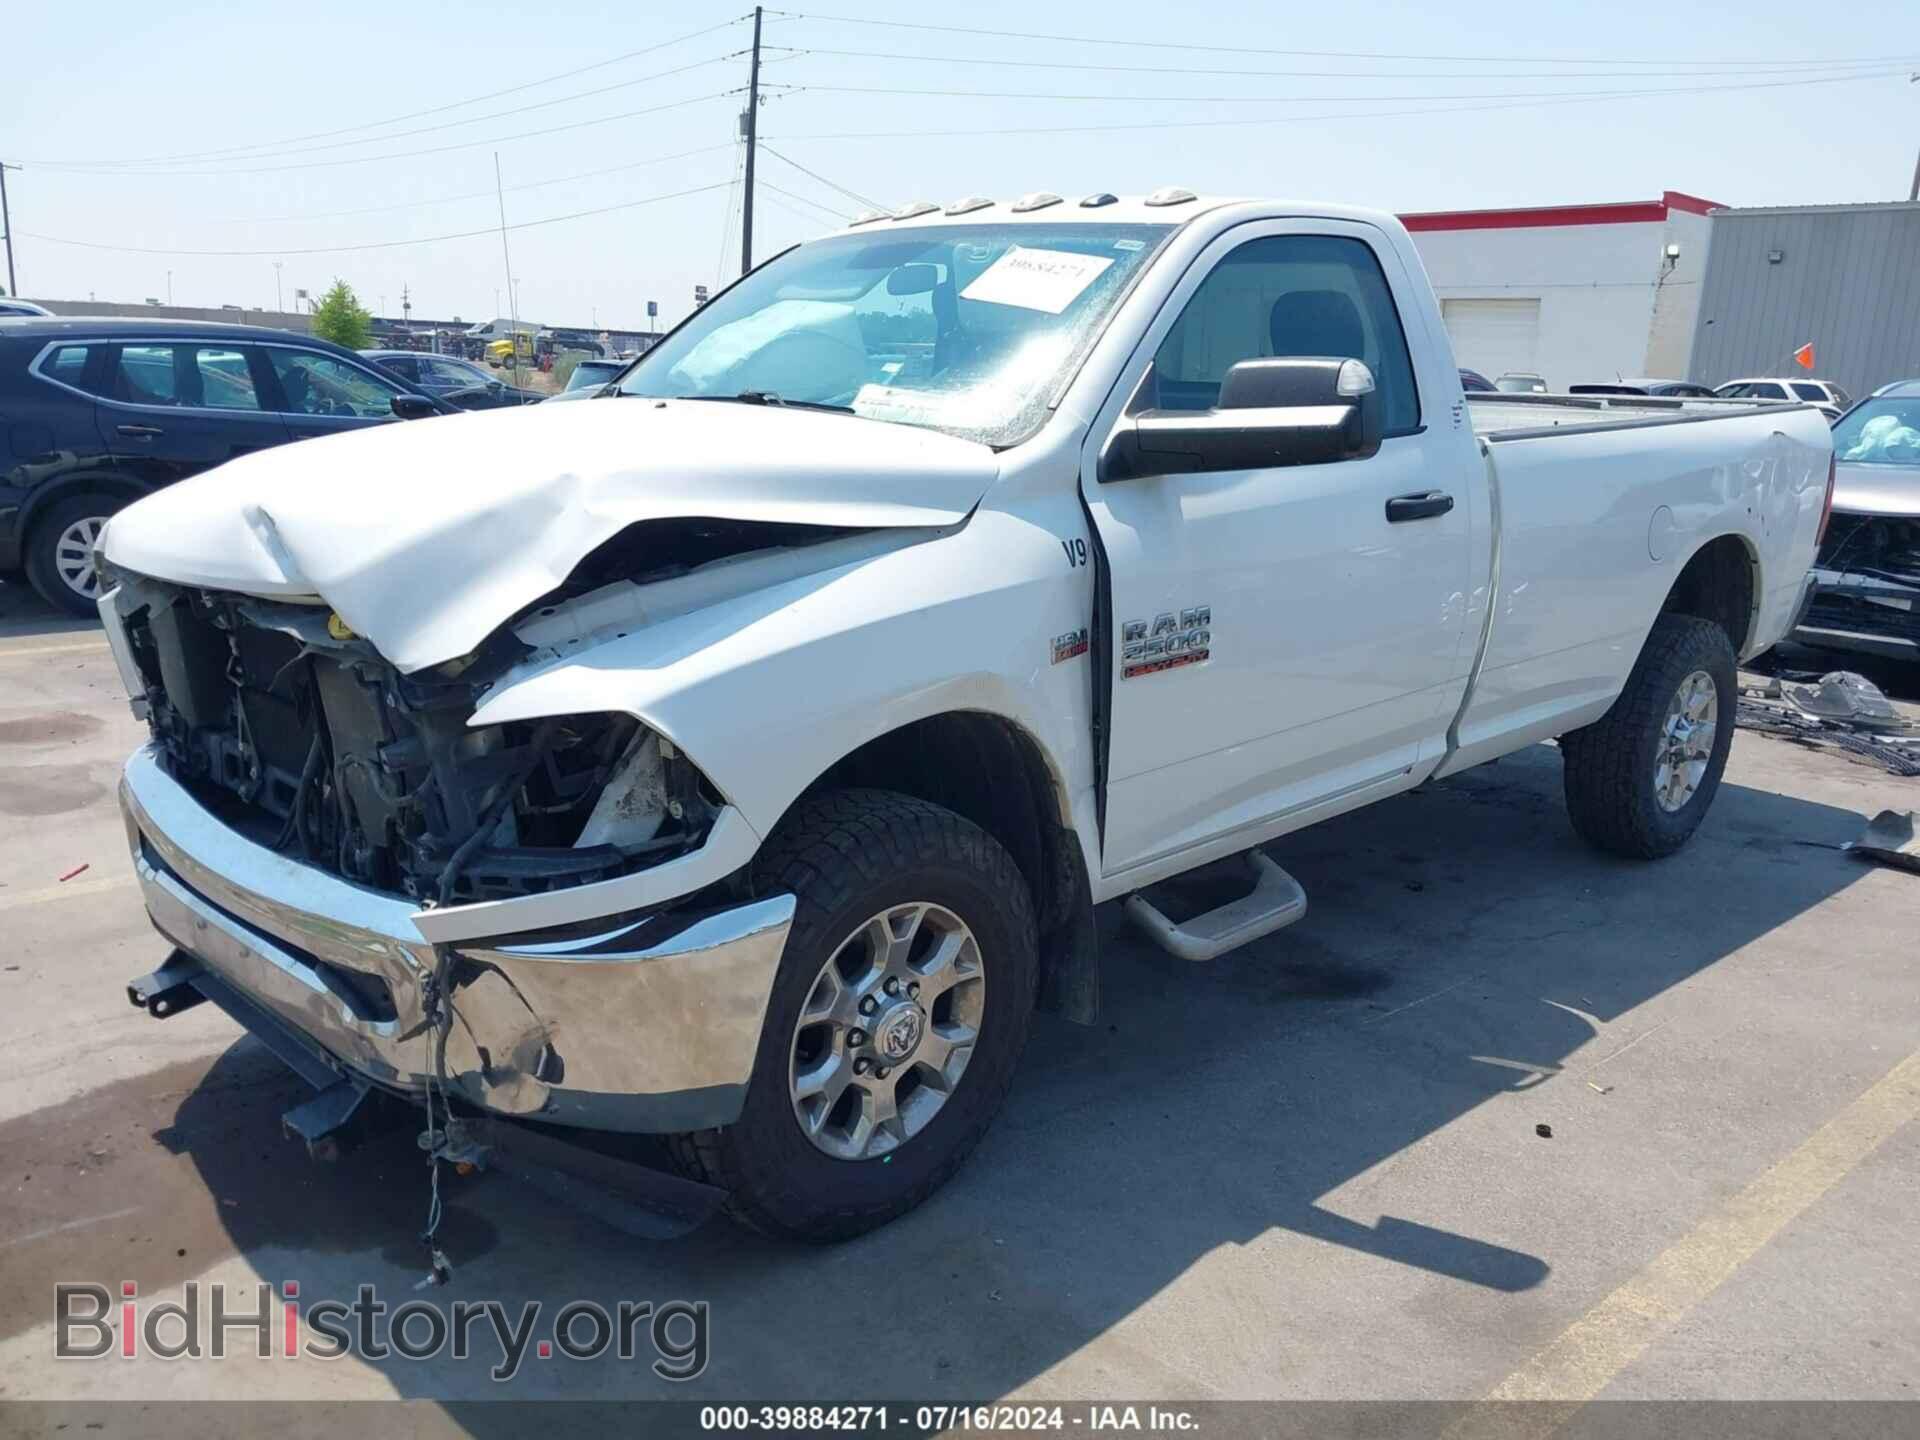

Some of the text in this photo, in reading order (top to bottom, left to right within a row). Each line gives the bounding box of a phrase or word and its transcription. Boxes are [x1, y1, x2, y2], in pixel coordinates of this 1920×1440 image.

[1061, 537, 1088, 568] V9
[1121, 605, 1211, 643] RAM
[1121, 628, 1211, 661] 2500
